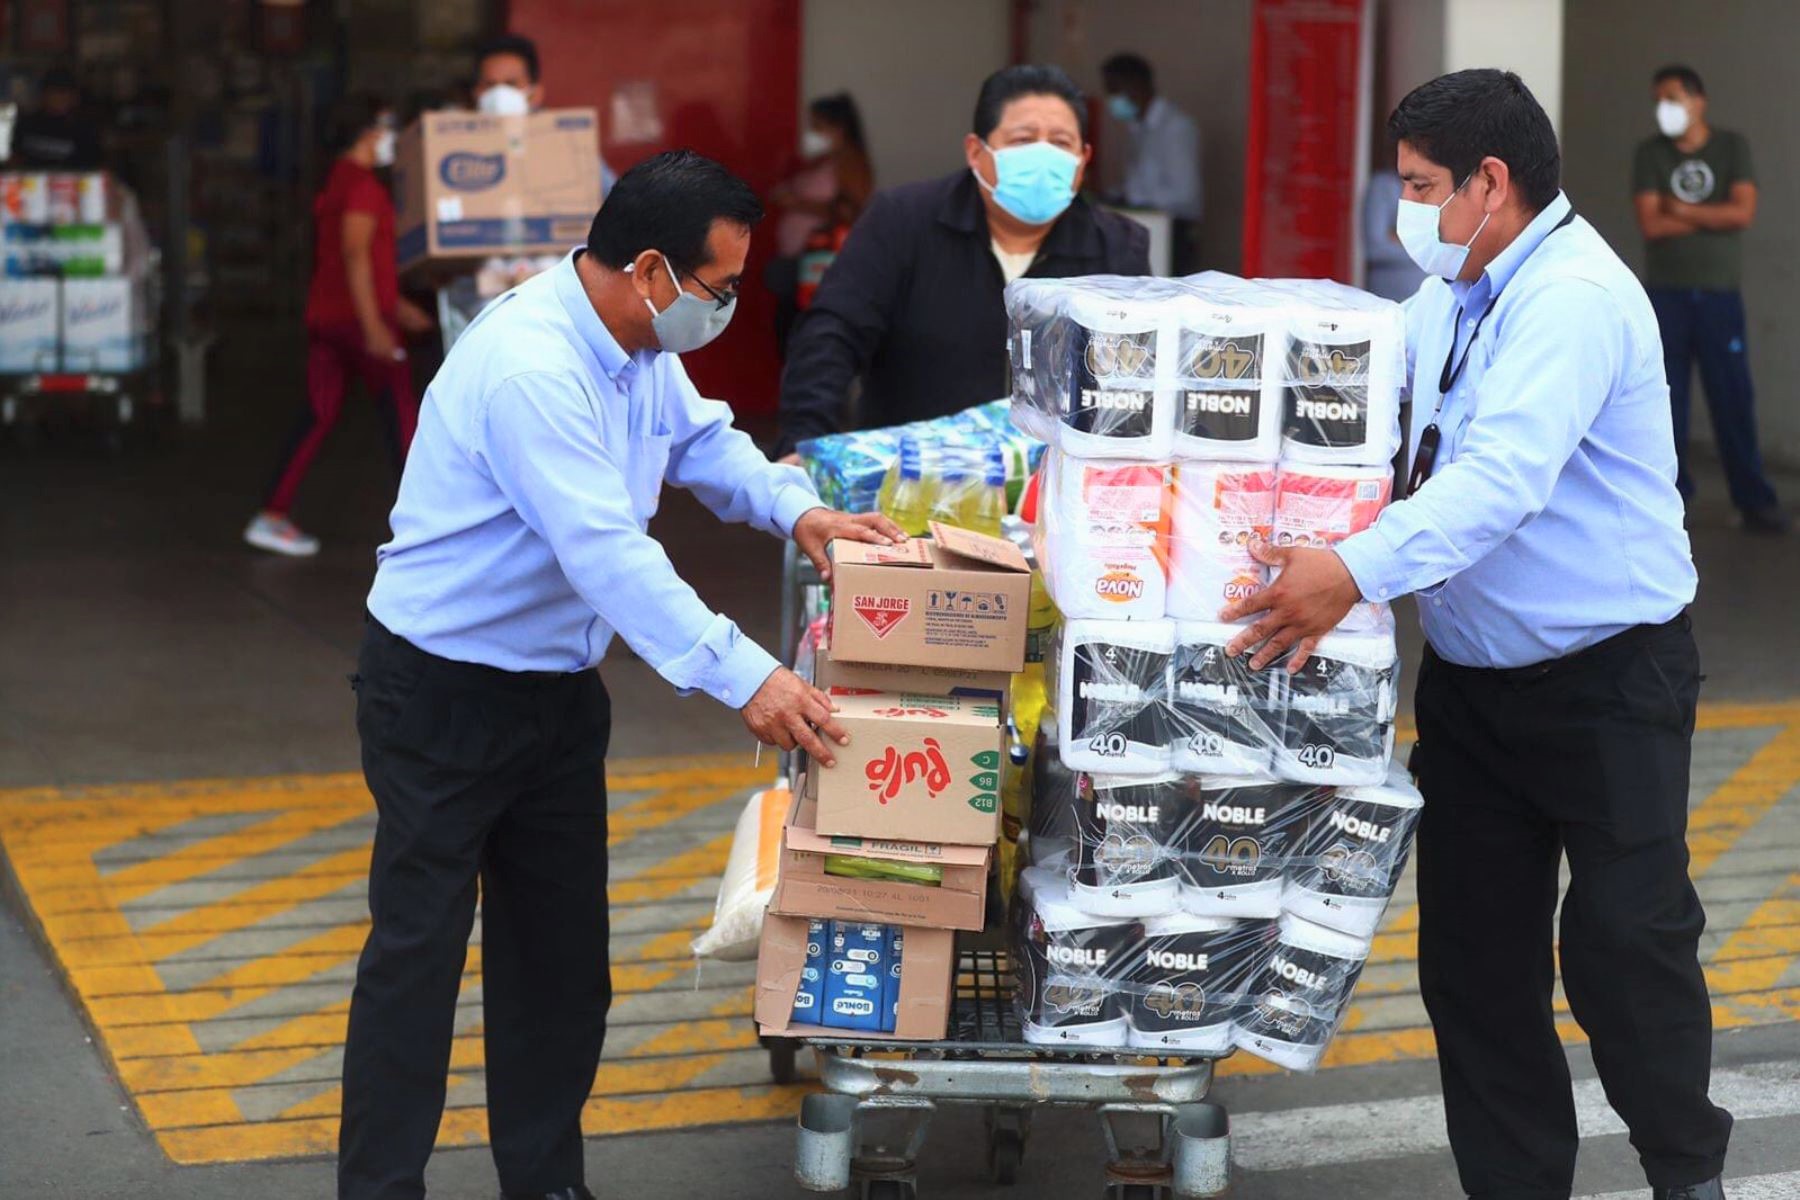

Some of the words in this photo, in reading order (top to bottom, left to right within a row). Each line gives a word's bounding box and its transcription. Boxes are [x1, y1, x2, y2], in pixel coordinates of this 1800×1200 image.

[1191, 341, 1254, 381] 40
[1081, 389, 1145, 411] NOBLE
[1187, 392, 1250, 414] NOBLE
[1296, 400, 1357, 421] NOBLE
[1095, 577, 1143, 598] Nova
[855, 596, 875, 607] SAN
[876, 598, 909, 610] JORGE
[1105, 647, 1116, 660] 4
[1204, 648, 1215, 660] 4
[1316, 660, 1327, 674] 4
[1089, 732, 1127, 755] 40
[1188, 731, 1224, 755] 40
[982, 755, 991, 765] C
[1298, 744, 1334, 767] 40
[865, 738, 951, 804] Pulp
[979, 777, 993, 786] B6
[974, 797, 993, 808] B12
[1096, 803, 1160, 823] NOBLE
[1203, 803, 1266, 824] NOBLE
[1329, 811, 1391, 843] NOBLE
[1199, 835, 1261, 874] 40
[1112, 890, 1118, 898] 4
[1217, 891, 1224, 899] 4
[1047, 945, 1106, 965] NOBLE
[1147, 950, 1208, 970] NOBLE
[1270, 956, 1327, 990] NOBLE
[1144, 980, 1205, 1018] 40
[1060, 1031, 1067, 1039] 4
[1161, 1036, 1168, 1044] 4
